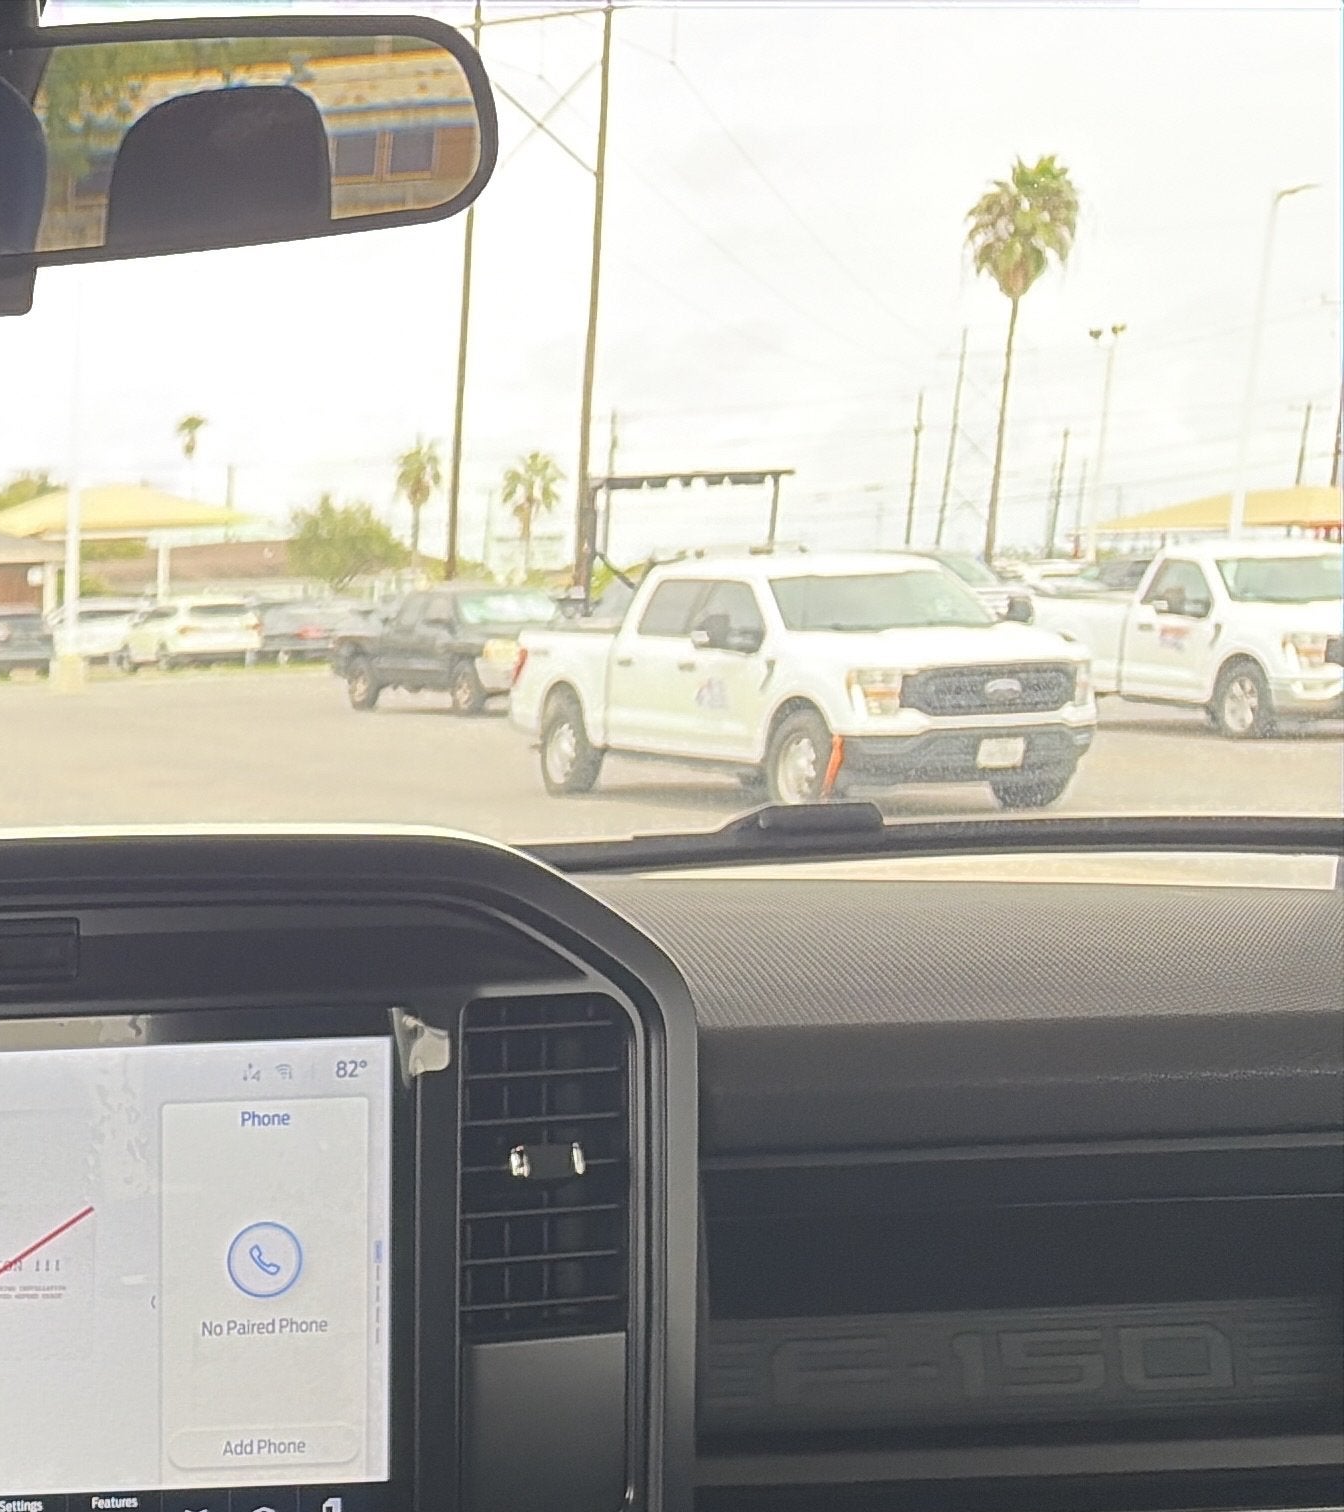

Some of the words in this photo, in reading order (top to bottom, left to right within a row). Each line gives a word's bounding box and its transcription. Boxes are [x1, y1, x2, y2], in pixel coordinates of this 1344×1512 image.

[335, 1060, 368, 1079] 82°
[240, 1111, 291, 1127] Phone
[201, 1320, 223, 1336] No
[226, 1318, 276, 1335] Paired
[279, 1317, 328, 1334] Phone
[770, 1320, 1236, 1403] F-150
[222, 1439, 253, 1456] Add
[257, 1438, 307, 1455] Phone
[91, 1496, 139, 1510] Features
